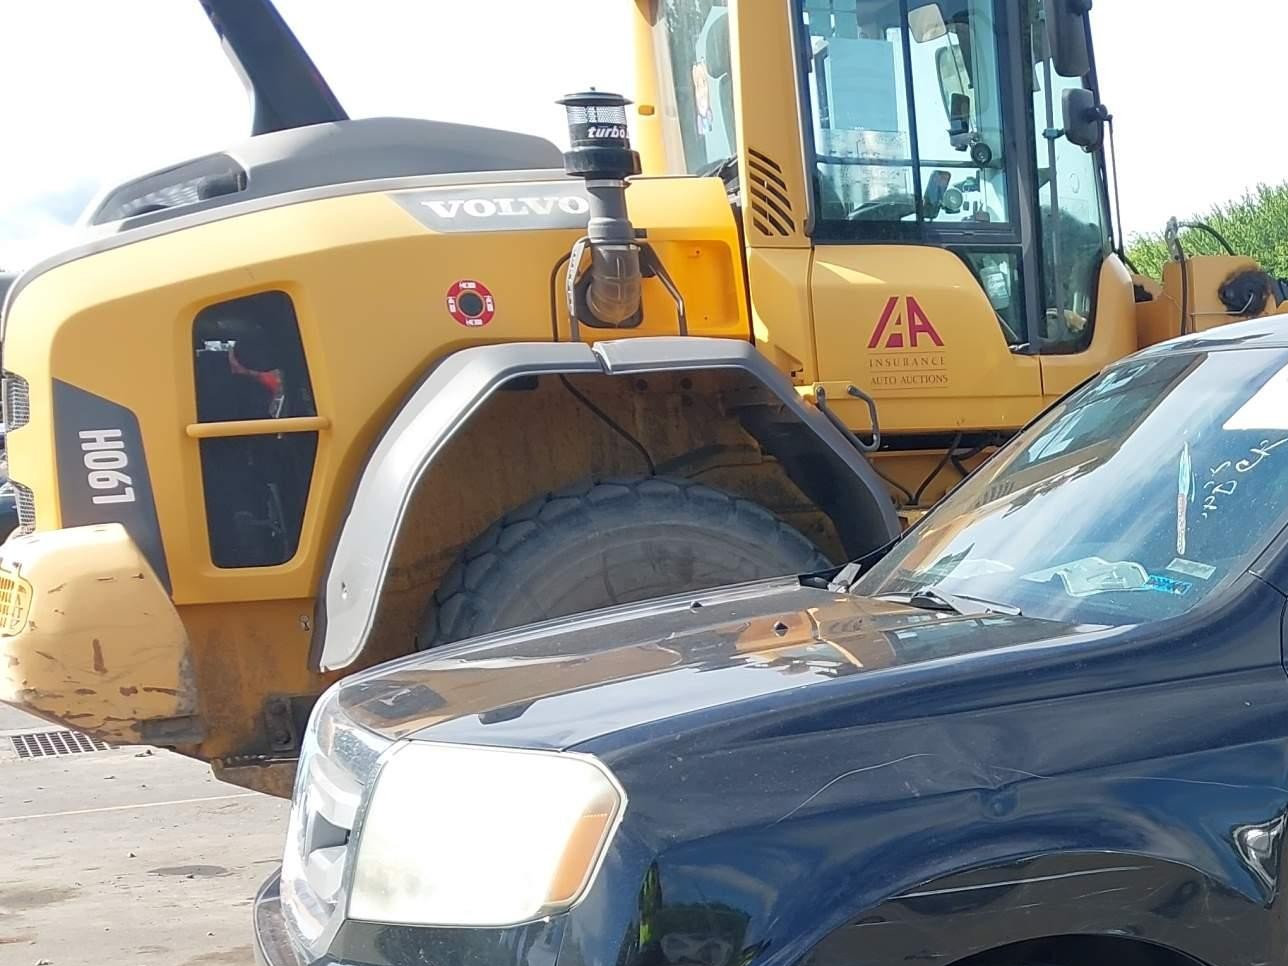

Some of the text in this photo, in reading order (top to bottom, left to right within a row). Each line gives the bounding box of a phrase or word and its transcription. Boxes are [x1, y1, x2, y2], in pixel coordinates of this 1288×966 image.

[421, 196, 589, 219] VOLVO
[869, 355, 945, 369] INSURANCE
[871, 374, 949, 386] AUTO AUCTIONS
